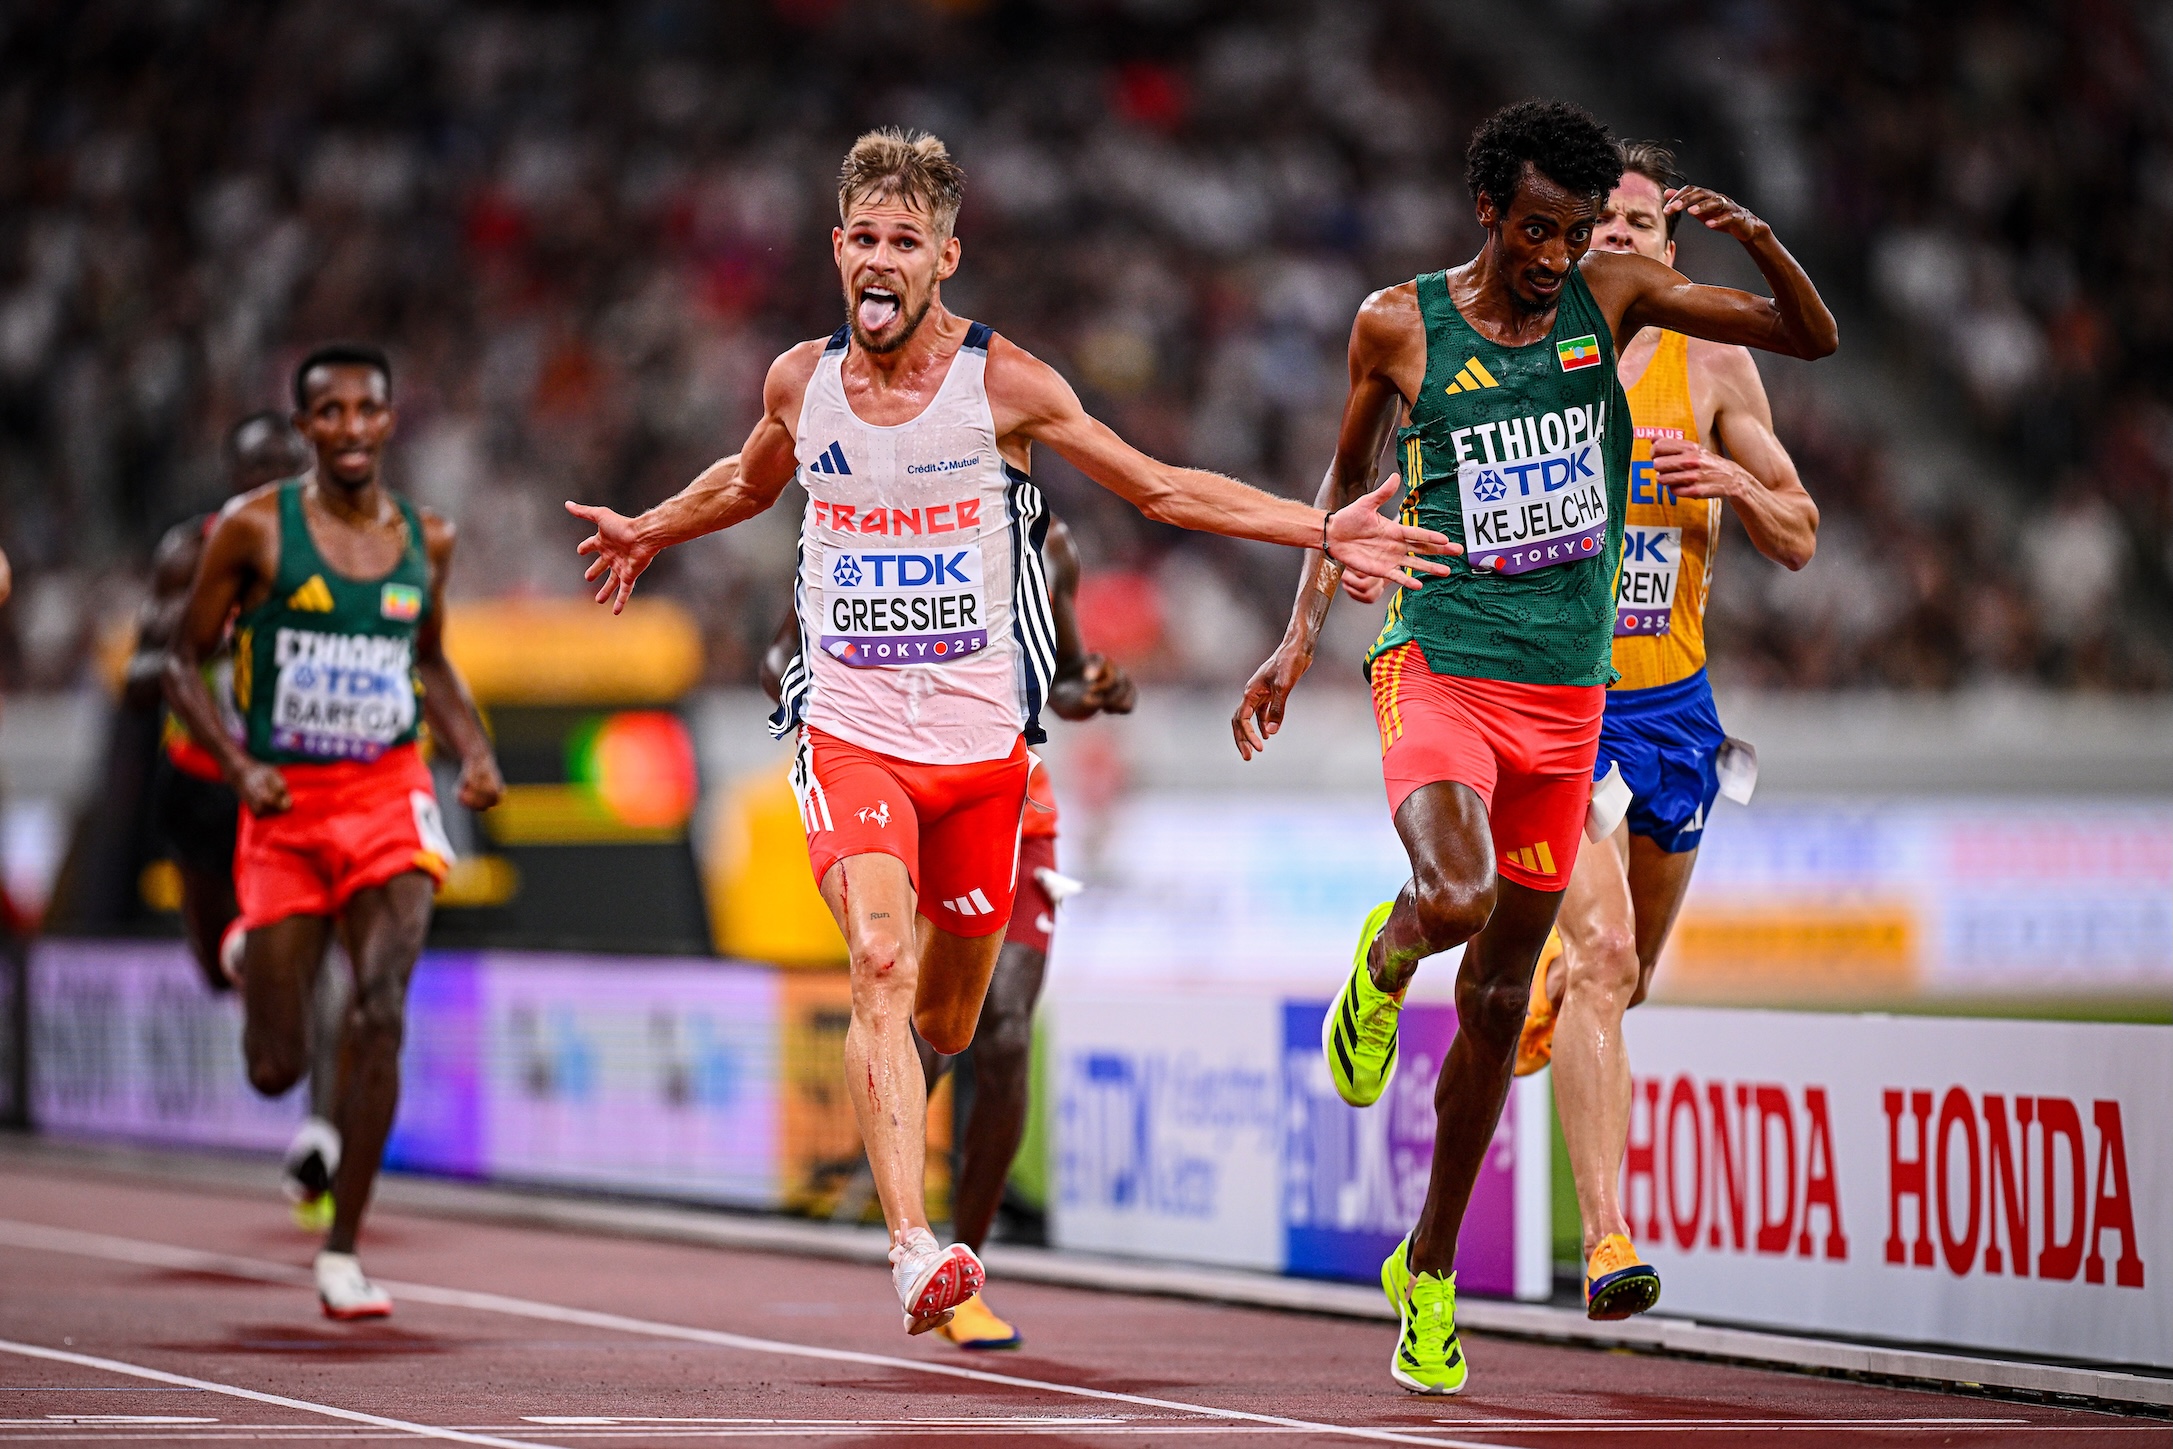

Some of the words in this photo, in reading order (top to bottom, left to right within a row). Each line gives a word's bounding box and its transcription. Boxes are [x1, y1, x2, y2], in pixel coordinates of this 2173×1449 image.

[1450, 401, 1606, 467] ETHIOPIA
[907, 464, 936, 475] Crédit
[949, 456, 980, 470] Mutuel
[1504, 447, 1595, 496] TDK
[813, 498, 981, 536] FRANCE
[1473, 485, 1605, 546] KEJELCHA
[861, 551, 971, 587] TDK
[832, 593, 978, 632] GRESSIER
[870, 911, 890, 920] Run
[1619, 1070, 1849, 1262] HONDA
[1882, 1084, 2145, 1289] HONDA
